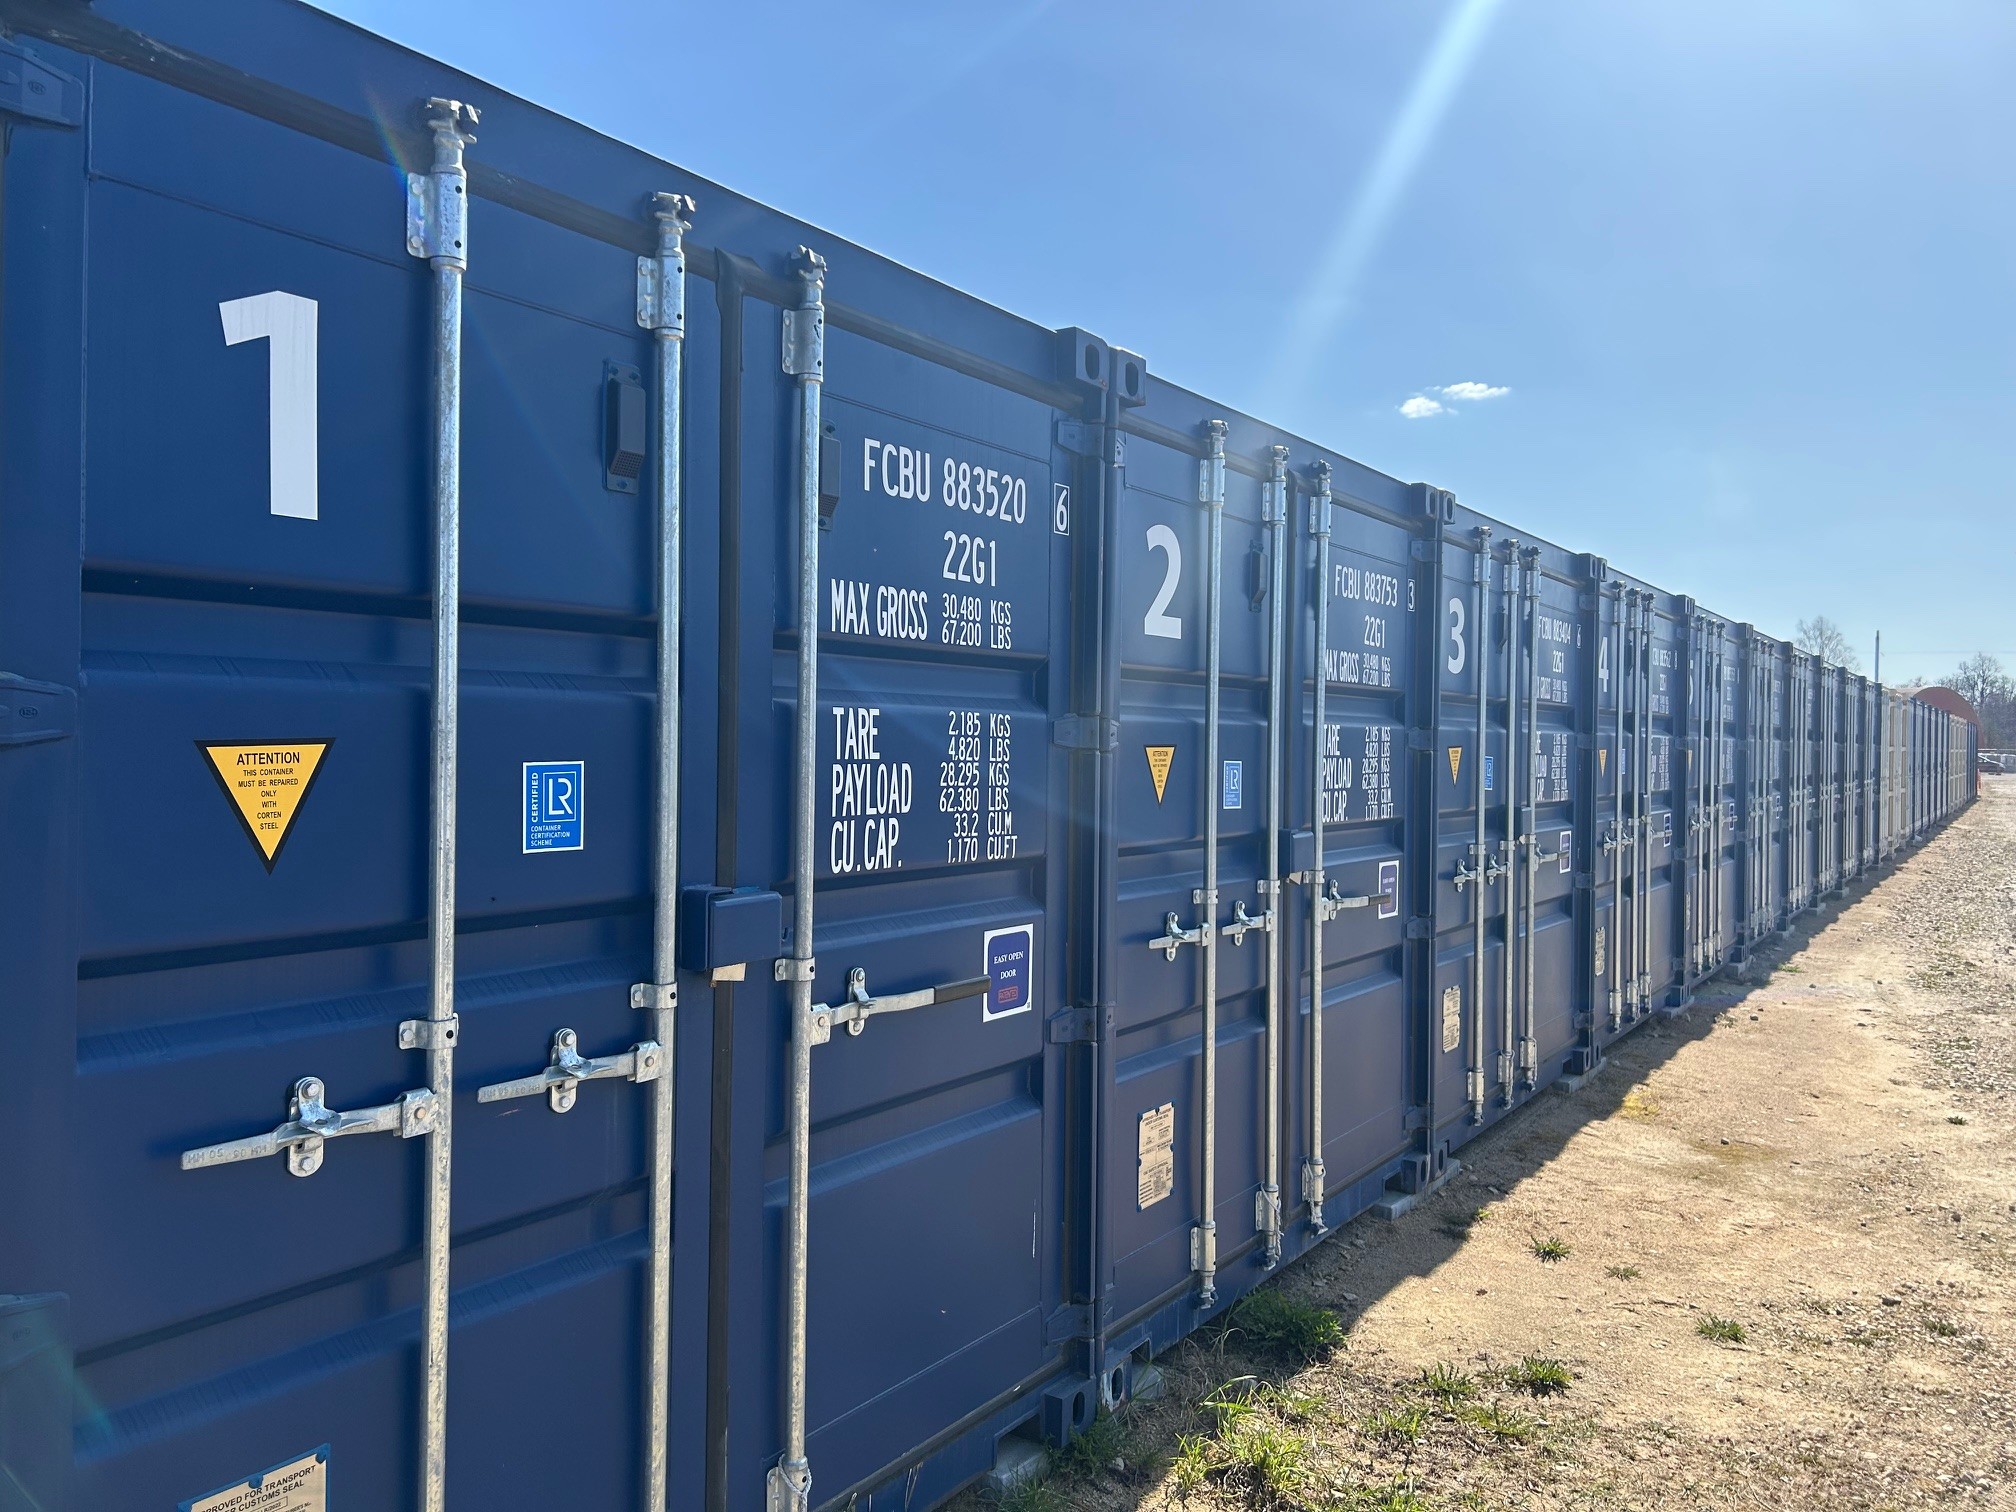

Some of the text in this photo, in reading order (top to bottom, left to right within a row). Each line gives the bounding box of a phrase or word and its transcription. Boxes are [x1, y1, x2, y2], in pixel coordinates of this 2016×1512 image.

[219, 290, 318, 520] 1
[863, 438, 1069, 531] FCBU 883520 6
[943, 531, 997, 587] 22G1
[1145, 524, 1182, 640] 2
[1335, 564, 1415, 610] FCBU 883753 3
[831, 579, 870, 635] MAX
[876, 586, 928, 641] GROSS
[990, 599, 1012, 626] KGS
[990, 624, 1012, 650] LBS
[1364, 615, 1385, 649] 22G1
[1448, 598, 1466, 675] 3
[1340, 651, 1360, 684] GROSS
[1599, 636, 1609, 693] 4
[833, 707, 880, 761] TARE
[990, 713, 1011, 738] KGS
[989, 738, 1011, 762] LBS
[1323, 724, 1341, 756] TARE
[237, 752, 300, 765] ATTENTION
[243, 768, 294, 777] THIS CONTAINER
[1322, 757, 1352, 789] PAYLOAD
[238, 780, 255, 788] MUST
[269, 778, 299, 786] REPAIRED
[531, 772, 539, 823] CERTIFIED
[548, 778, 574, 815] LR
[832, 763, 913, 818] PAYLOAD
[988, 762, 1010, 787] KGS
[988, 787, 1009, 811] LBS
[256, 811, 282, 820] CORTEN
[259, 822, 279, 830] STEEL
[530, 831, 571, 840] CERTIFICATION
[530, 839, 553, 847] SCHEME
[830, 811, 1012, 875] CU.CAP. 33.2 CU.M
[993, 951, 1024, 965] EASY OPEN
[1000, 968, 1017, 980] DOOR
[238, 1489, 280, 1512] CUSTOMS
[282, 1480, 304, 1494] SEAL
[245, 1488, 262, 1500] FOR
[264, 1465, 316, 1492] TRANSPORT
